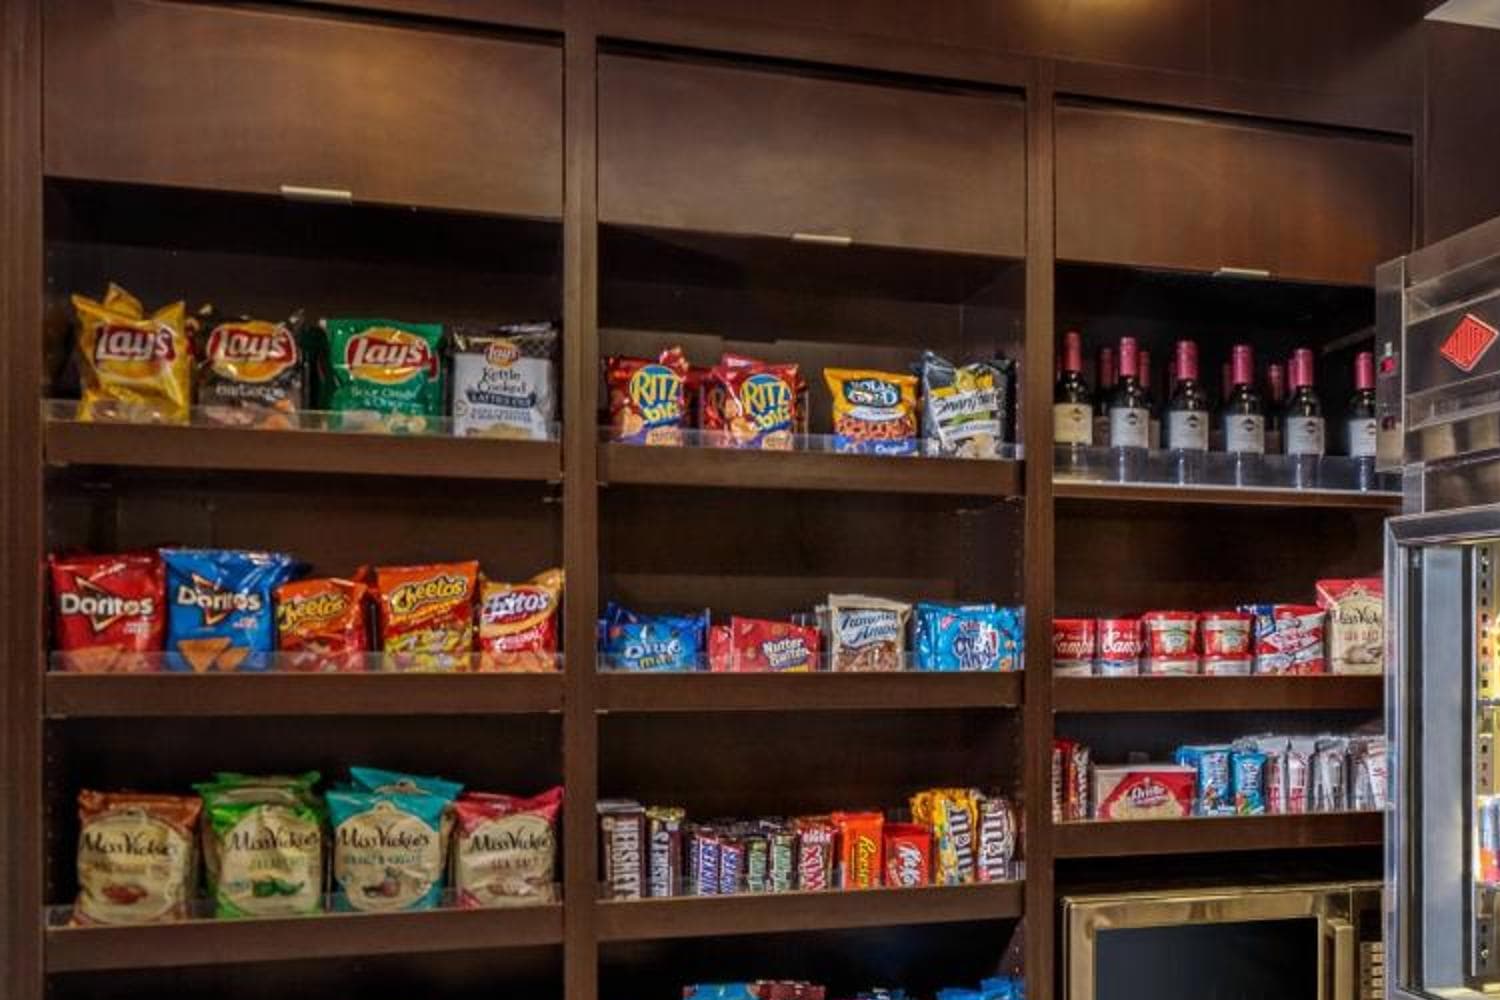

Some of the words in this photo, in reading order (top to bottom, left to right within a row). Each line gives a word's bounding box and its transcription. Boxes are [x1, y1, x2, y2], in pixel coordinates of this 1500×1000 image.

[632, 371, 680, 403] RITZ
[742, 380, 791, 414] RITZ
[60, 593, 153, 615] Doritos
[177, 586, 261, 611] Doritos
[391, 580, 464, 613] Cheetos
[801, 846, 826, 890] WIX
